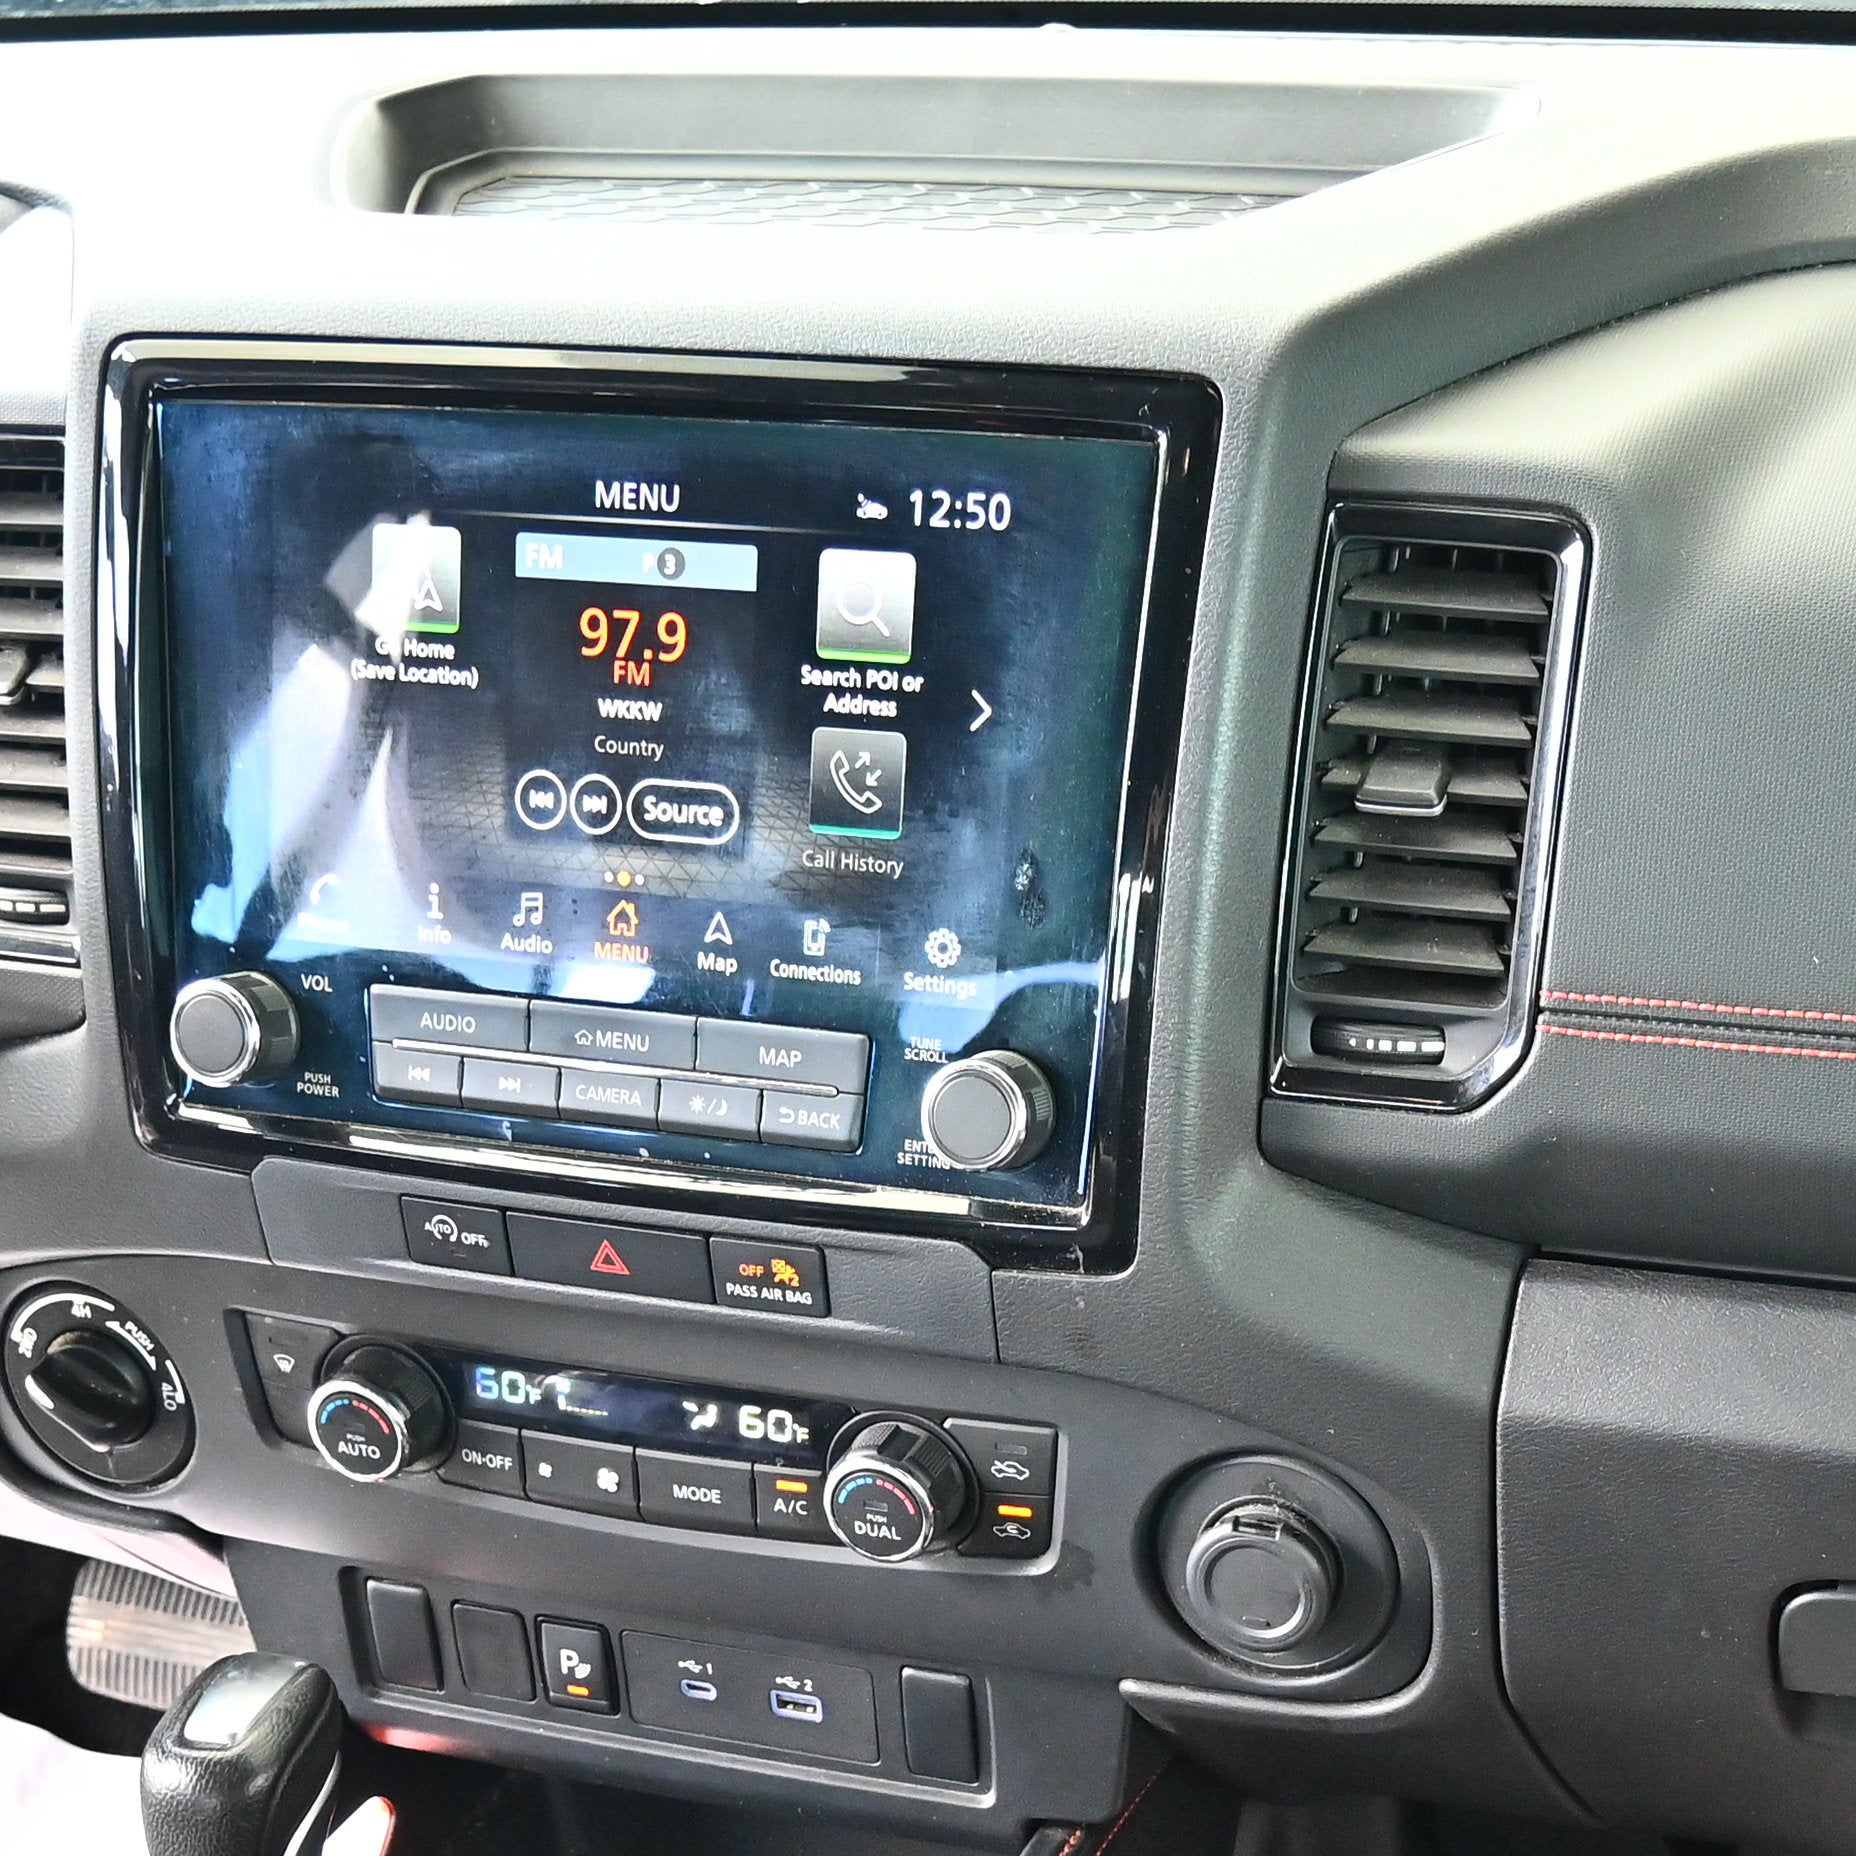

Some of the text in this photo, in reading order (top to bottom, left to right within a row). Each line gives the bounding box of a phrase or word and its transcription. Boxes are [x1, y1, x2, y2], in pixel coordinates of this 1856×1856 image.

[594, 479, 681, 513] MENU
[909, 488, 1011, 531] 12:50
[524, 542, 564, 570] FM
[663, 554, 677, 576] 3
[579, 607, 688, 663] 97.9
[404, 638, 455, 660] Home
[350, 658, 479, 689] (Save Location)
[613, 660, 651, 687] FM
[800, 664, 924, 692] Search POI or
[597, 698, 663, 721] WKKW
[823, 693, 897, 717] Address
[594, 735, 664, 762] Country
[643, 795, 724, 827] Source
[802, 849, 904, 879] Call History
[418, 925, 452, 944] Info
[500, 932, 553, 955] Audio
[594, 941, 650, 964] MENU
[697, 951, 738, 977] Map
[300, 973, 334, 993] VOL
[769, 958, 861, 986] Connections
[903, 971, 978, 1000] Settings
[420, 1011, 477, 1034] AUDIO
[595, 1029, 650, 1053] MENU
[910, 1036, 943, 1051] TUNE
[759, 1047, 803, 1069] MAP
[904, 1048, 949, 1064] SCROLL
[304, 1071, 332, 1085] PUSH
[296, 1081, 340, 1099] POWER
[575, 1084, 642, 1108] CAMERA
[797, 1111, 841, 1131] BACK
[461, 1232, 486, 1247] OFF
[738, 1263, 765, 1278] OFF
[726, 1282, 813, 1305] PASS AIR BAG
[71, 1303, 92, 1319] 4H
[124, 1321, 155, 1351] PUSH
[338, 1441, 380, 1460] AUTO
[673, 1485, 722, 1505] MODE
[774, 1498, 808, 1516] A/C
[866, 1513, 887, 1524] PUSH
[854, 1520, 902, 1542] DUAL
[559, 1648, 580, 1675] P
[706, 1663, 713, 1675] 1
[803, 1679, 814, 1692] 2
